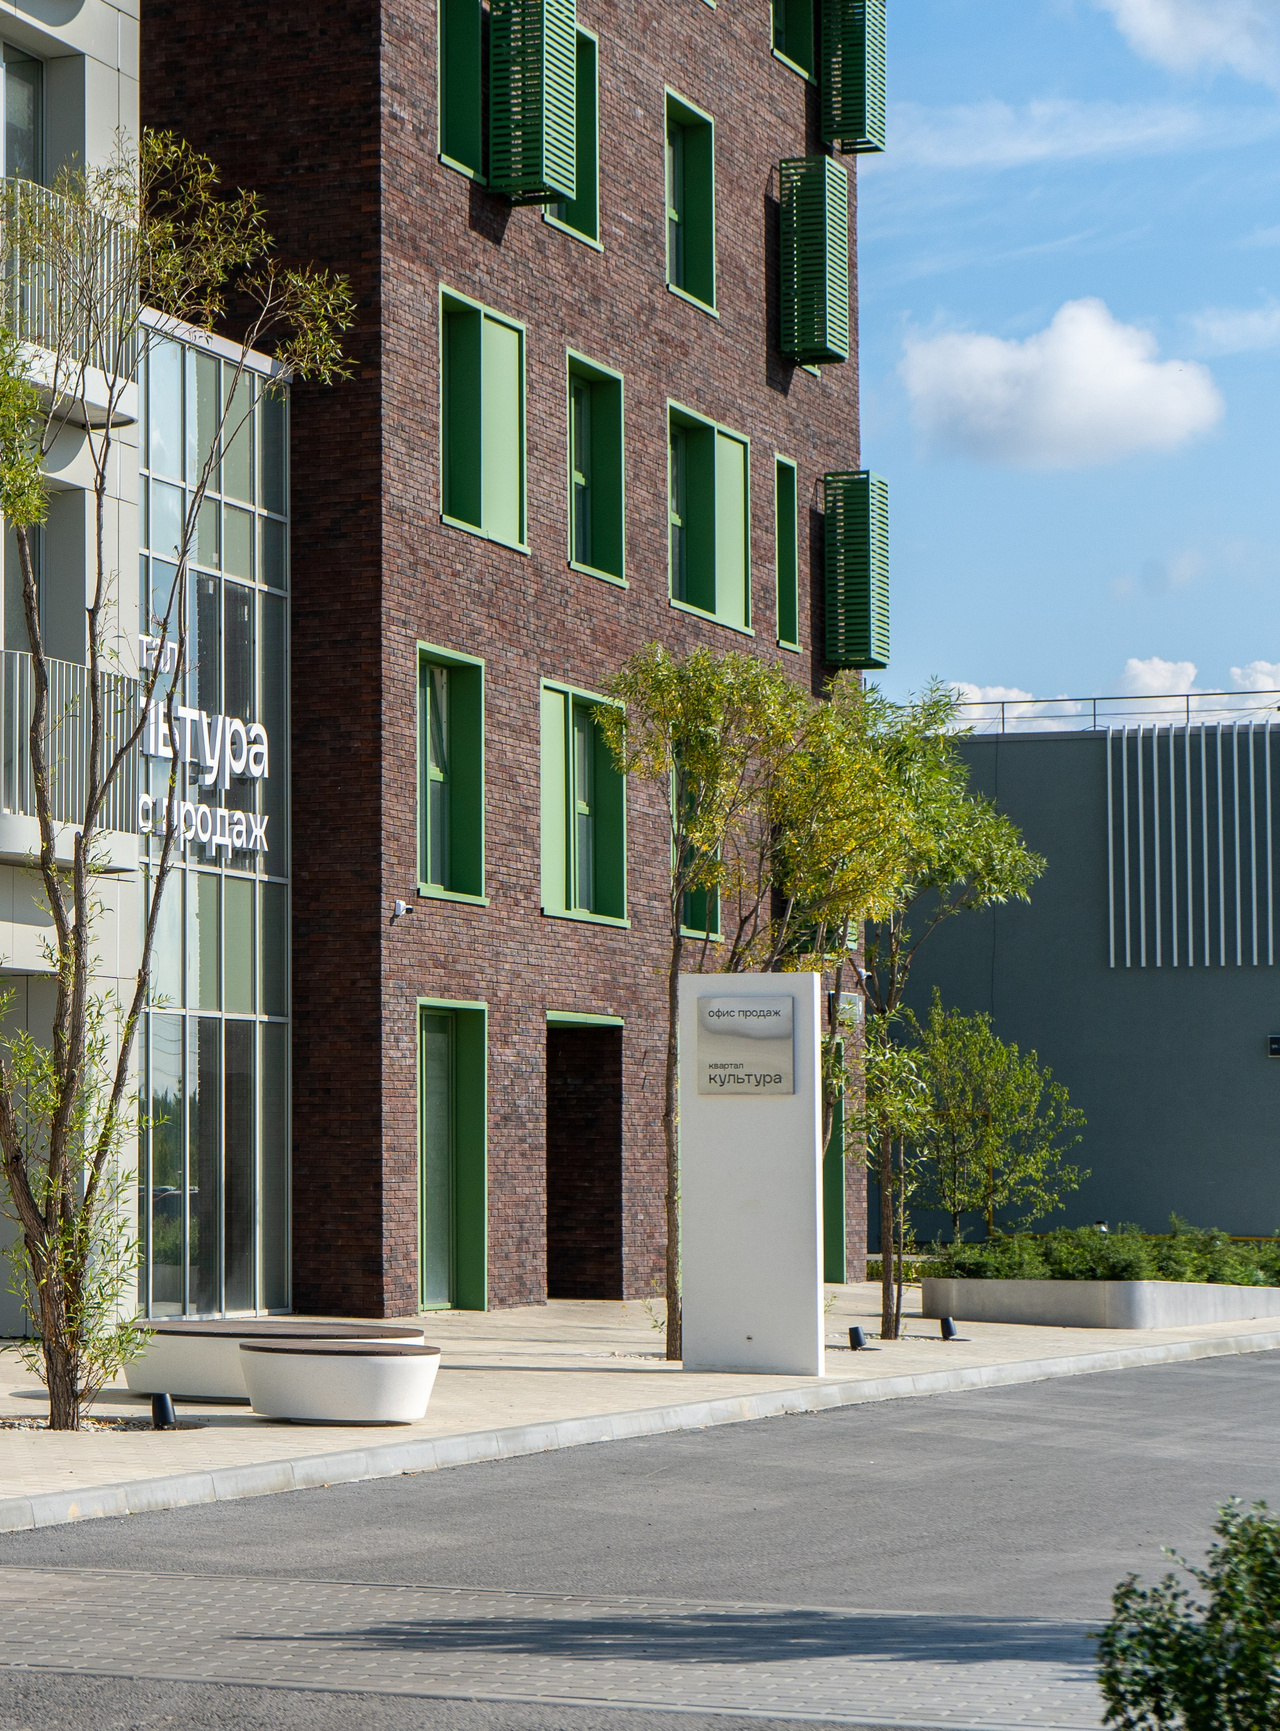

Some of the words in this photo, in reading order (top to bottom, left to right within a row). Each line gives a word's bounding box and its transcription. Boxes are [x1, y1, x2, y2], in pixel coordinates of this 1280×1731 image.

[708, 1008, 735, 1019] офис
[738, 1009, 781, 1019] продаж
[708, 1073, 782, 1087] культура
